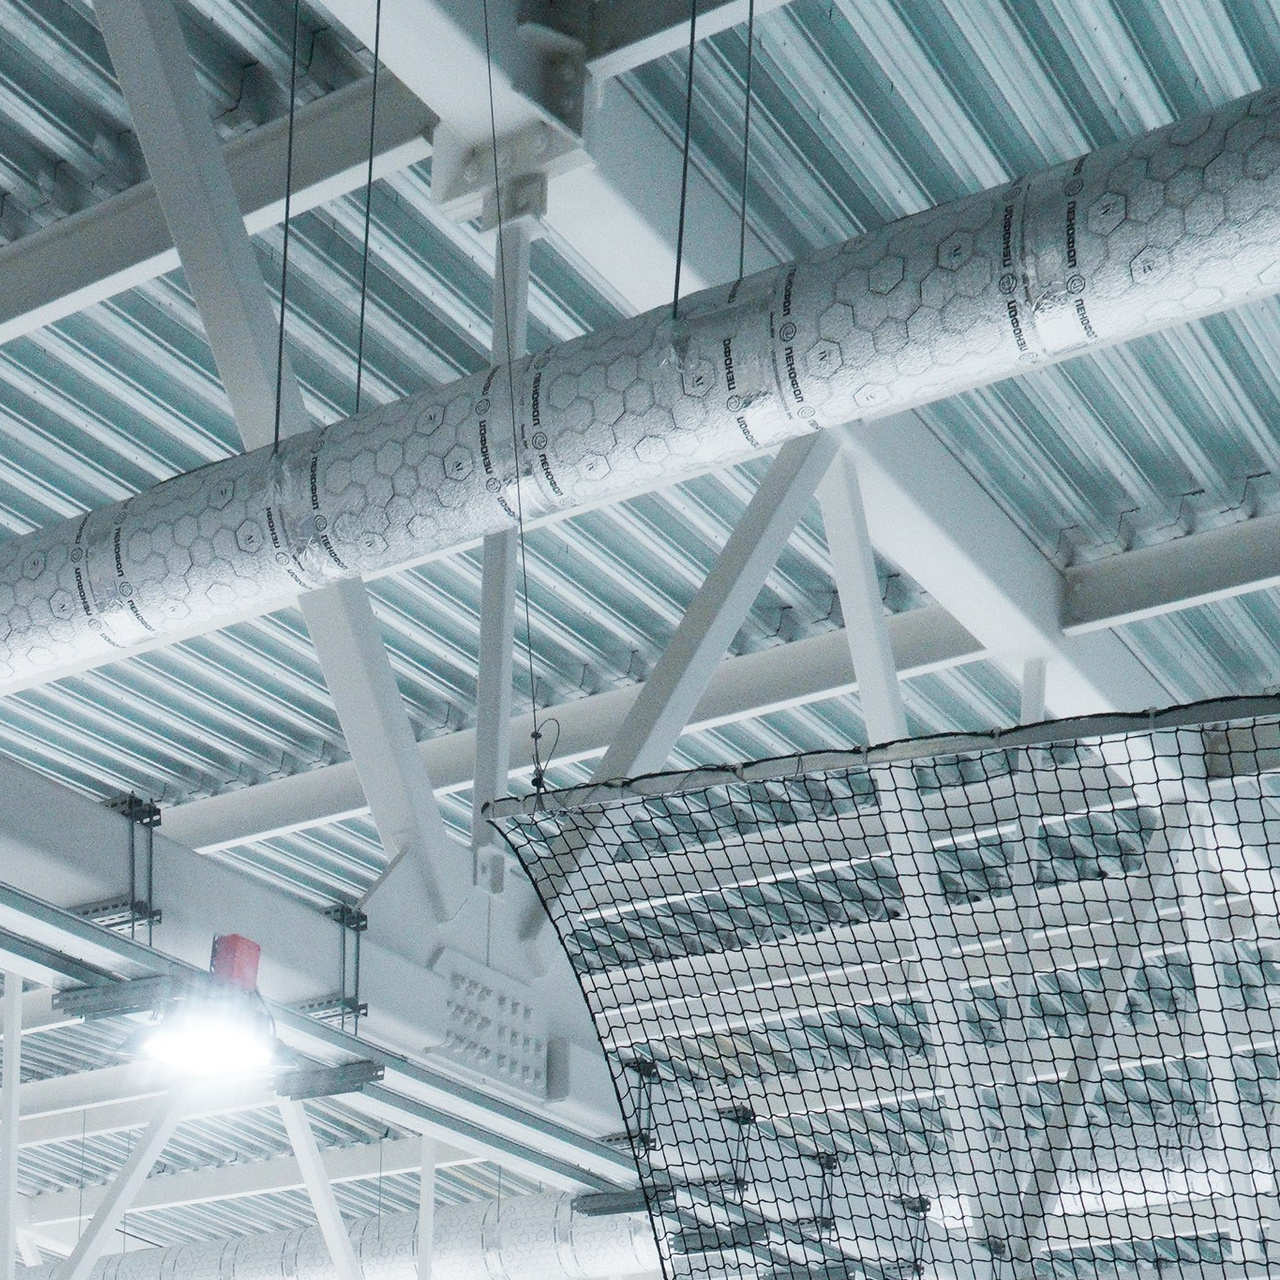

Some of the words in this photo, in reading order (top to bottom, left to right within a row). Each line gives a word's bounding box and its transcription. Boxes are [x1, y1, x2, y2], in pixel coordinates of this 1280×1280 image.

[1066, 200, 1077, 269] ПЕНОФОЛ
[1006, 299, 1029, 352] ПЕНОФОЛ
[531, 372, 542, 426] ПЕНОФОЛ
[785, 346, 804, 403] ПЕНОФОЛ
[479, 419, 493, 475] ПЕНОФОЛ
[539, 453, 564, 496] ПЕНОФОЛ
[74, 567, 92, 616] ПЕНОФОЛ
